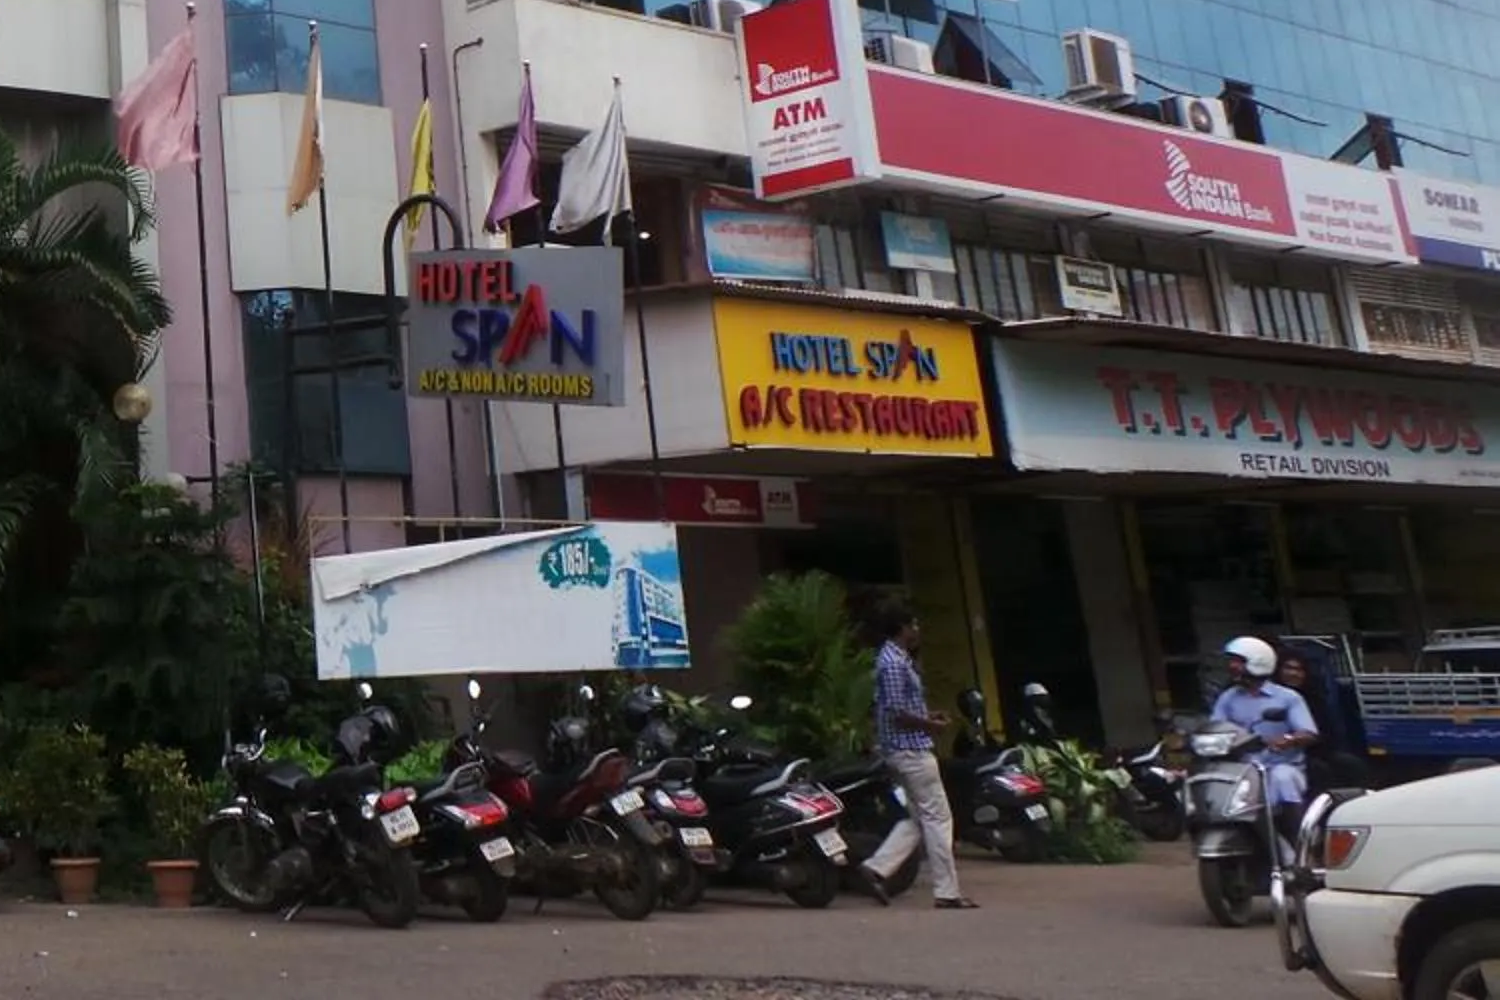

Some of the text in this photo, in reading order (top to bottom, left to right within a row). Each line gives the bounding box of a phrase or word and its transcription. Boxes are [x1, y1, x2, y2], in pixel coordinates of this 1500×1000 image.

[773, 97, 827, 130] ATM
[1187, 173, 1240, 201] SOUTH
[1190, 194, 1276, 224] INDIAN Bank
[416, 259, 521, 304] HOTEL
[452, 283, 597, 367] SPAN
[770, 329, 939, 381] HOTEL SPAN
[527, 374, 593, 398] ROOMS
[740, 385, 980, 441] A/C RESTAURANT
[1097, 366, 1485, 454] T.T. PLYWOODS
[1240, 453, 1390, 477] RETAIL DIVISION
